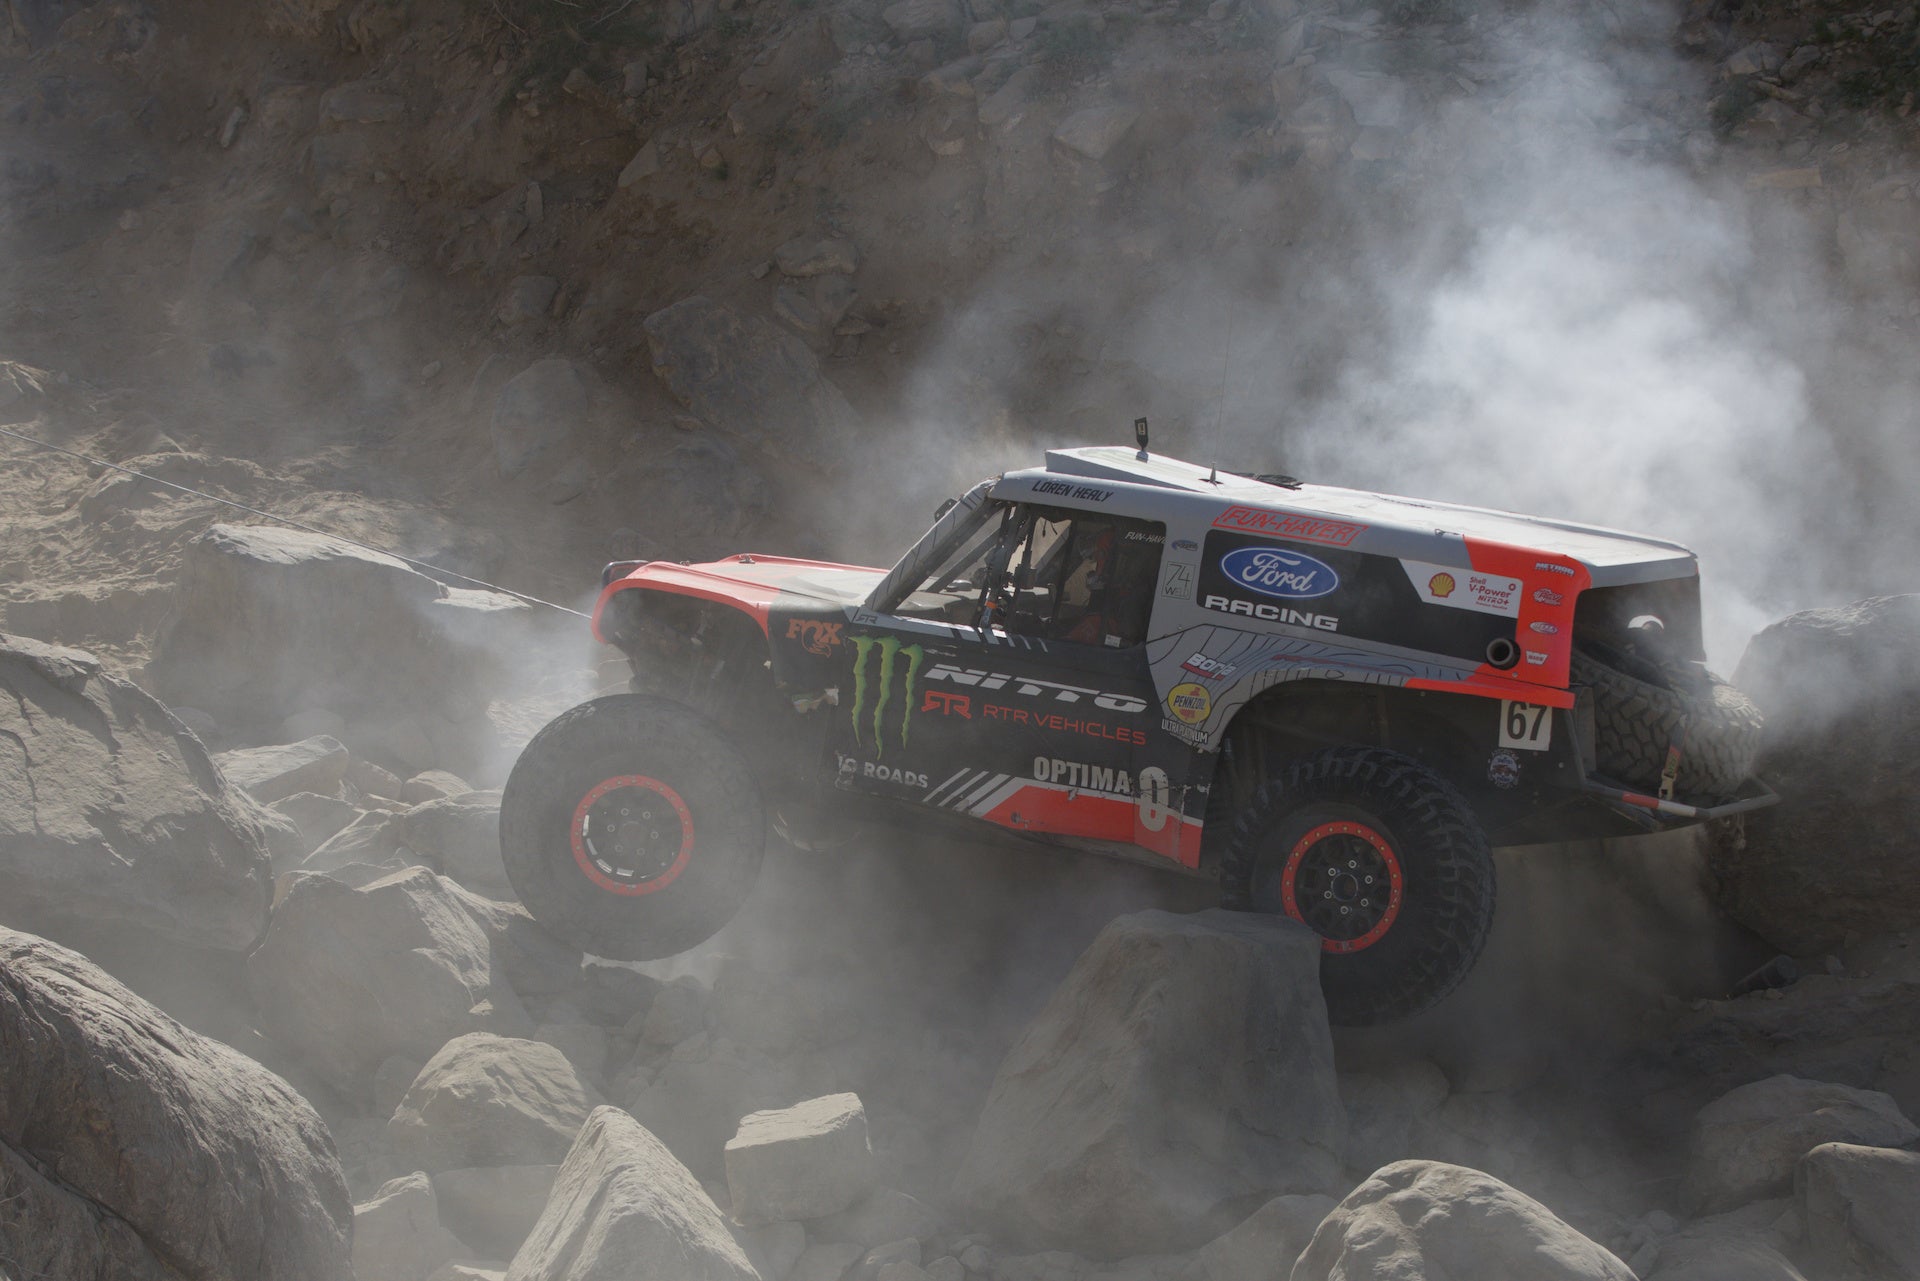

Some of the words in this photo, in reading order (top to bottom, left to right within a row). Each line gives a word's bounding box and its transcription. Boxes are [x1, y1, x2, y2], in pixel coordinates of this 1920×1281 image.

[1032, 480, 1075, 496] LOREN
[1072, 487, 1114, 502] HEALY
[1223, 509, 1353, 541] FUN-HAVER
[1166, 563, 1191, 586] 74
[1242, 553, 1317, 592] Ford
[1470, 576, 1487, 585] Shell
[1469, 584, 1511, 598] V-Power
[1204, 595, 1339, 631] RACING
[785, 618, 843, 655] FOX
[983, 704, 1029, 725] RTR
[1033, 712, 1147, 746] VEHICLES
[1507, 701, 1547, 741] 67
[864, 761, 929, 788] ROADS
[1033, 756, 1132, 793] OPTIMA
